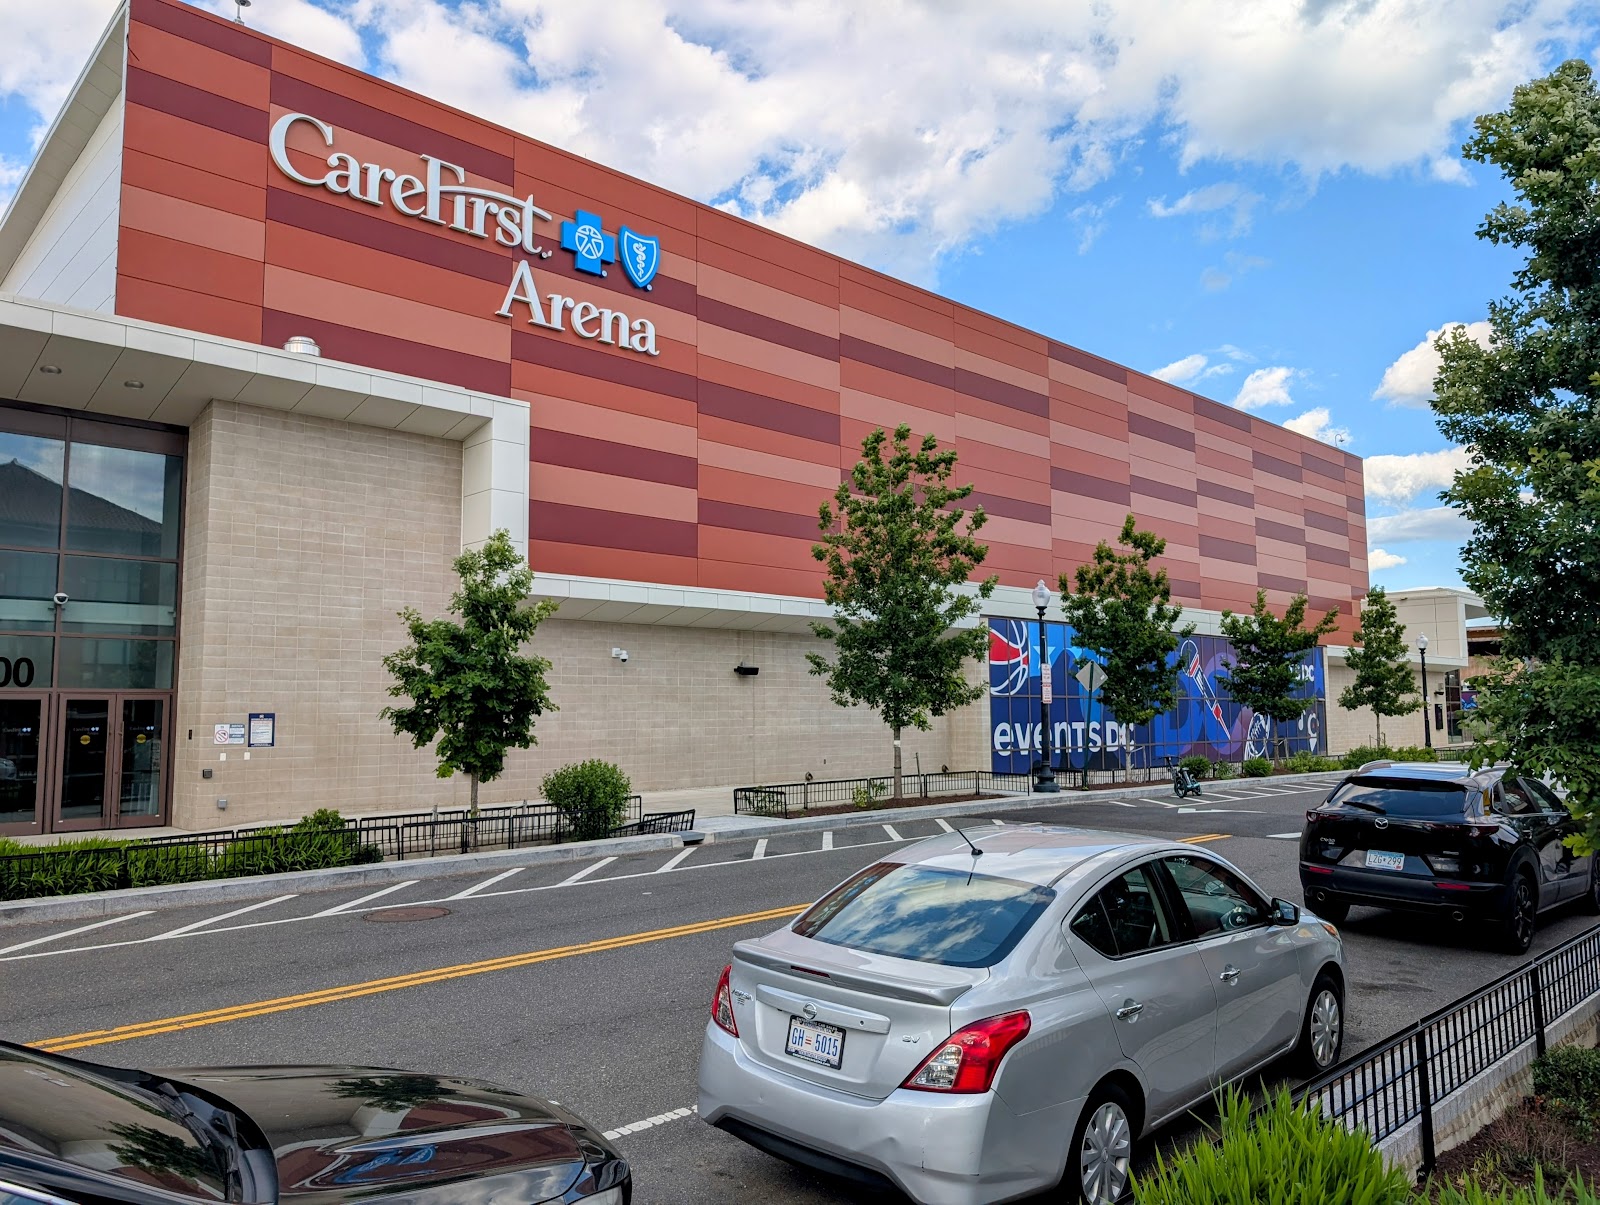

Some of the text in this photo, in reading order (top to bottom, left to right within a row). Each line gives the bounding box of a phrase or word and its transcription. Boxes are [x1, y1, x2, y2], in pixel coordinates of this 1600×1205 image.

[495, 259, 660, 357] Arena
[791, 1027, 805, 1047] GH
[814, 1033, 839, 1057] 5015
